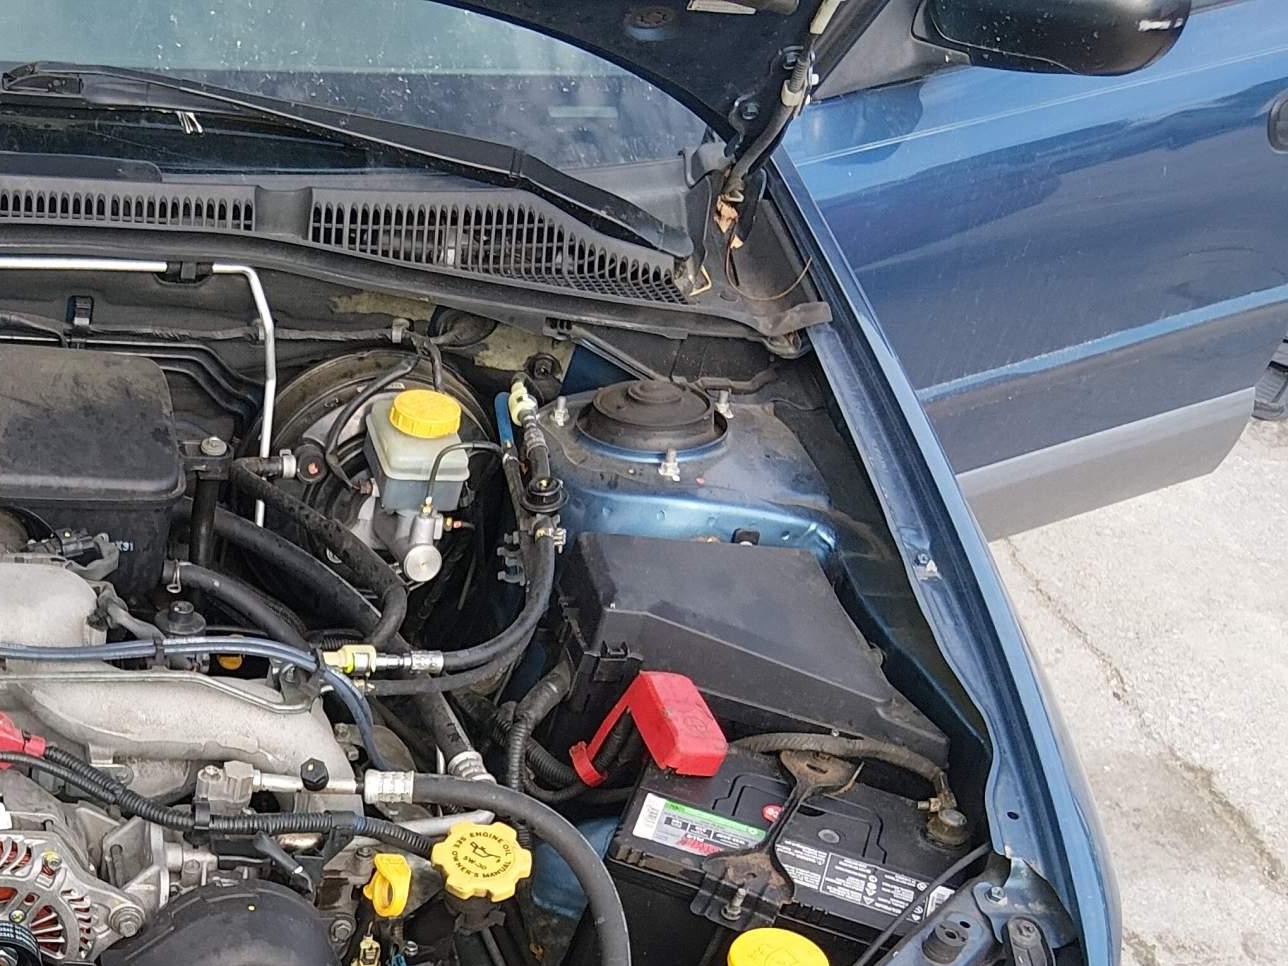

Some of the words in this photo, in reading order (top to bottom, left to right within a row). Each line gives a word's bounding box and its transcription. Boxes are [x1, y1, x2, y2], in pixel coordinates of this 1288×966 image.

[453, 836, 467, 849] SEE
[469, 831, 504, 844] ENGINE
[502, 844, 513, 857] OIL
[451, 850, 480, 878] OWNER'S
[482, 860, 512, 878] MANUAL
[463, 855, 488, 870] 5W-30
